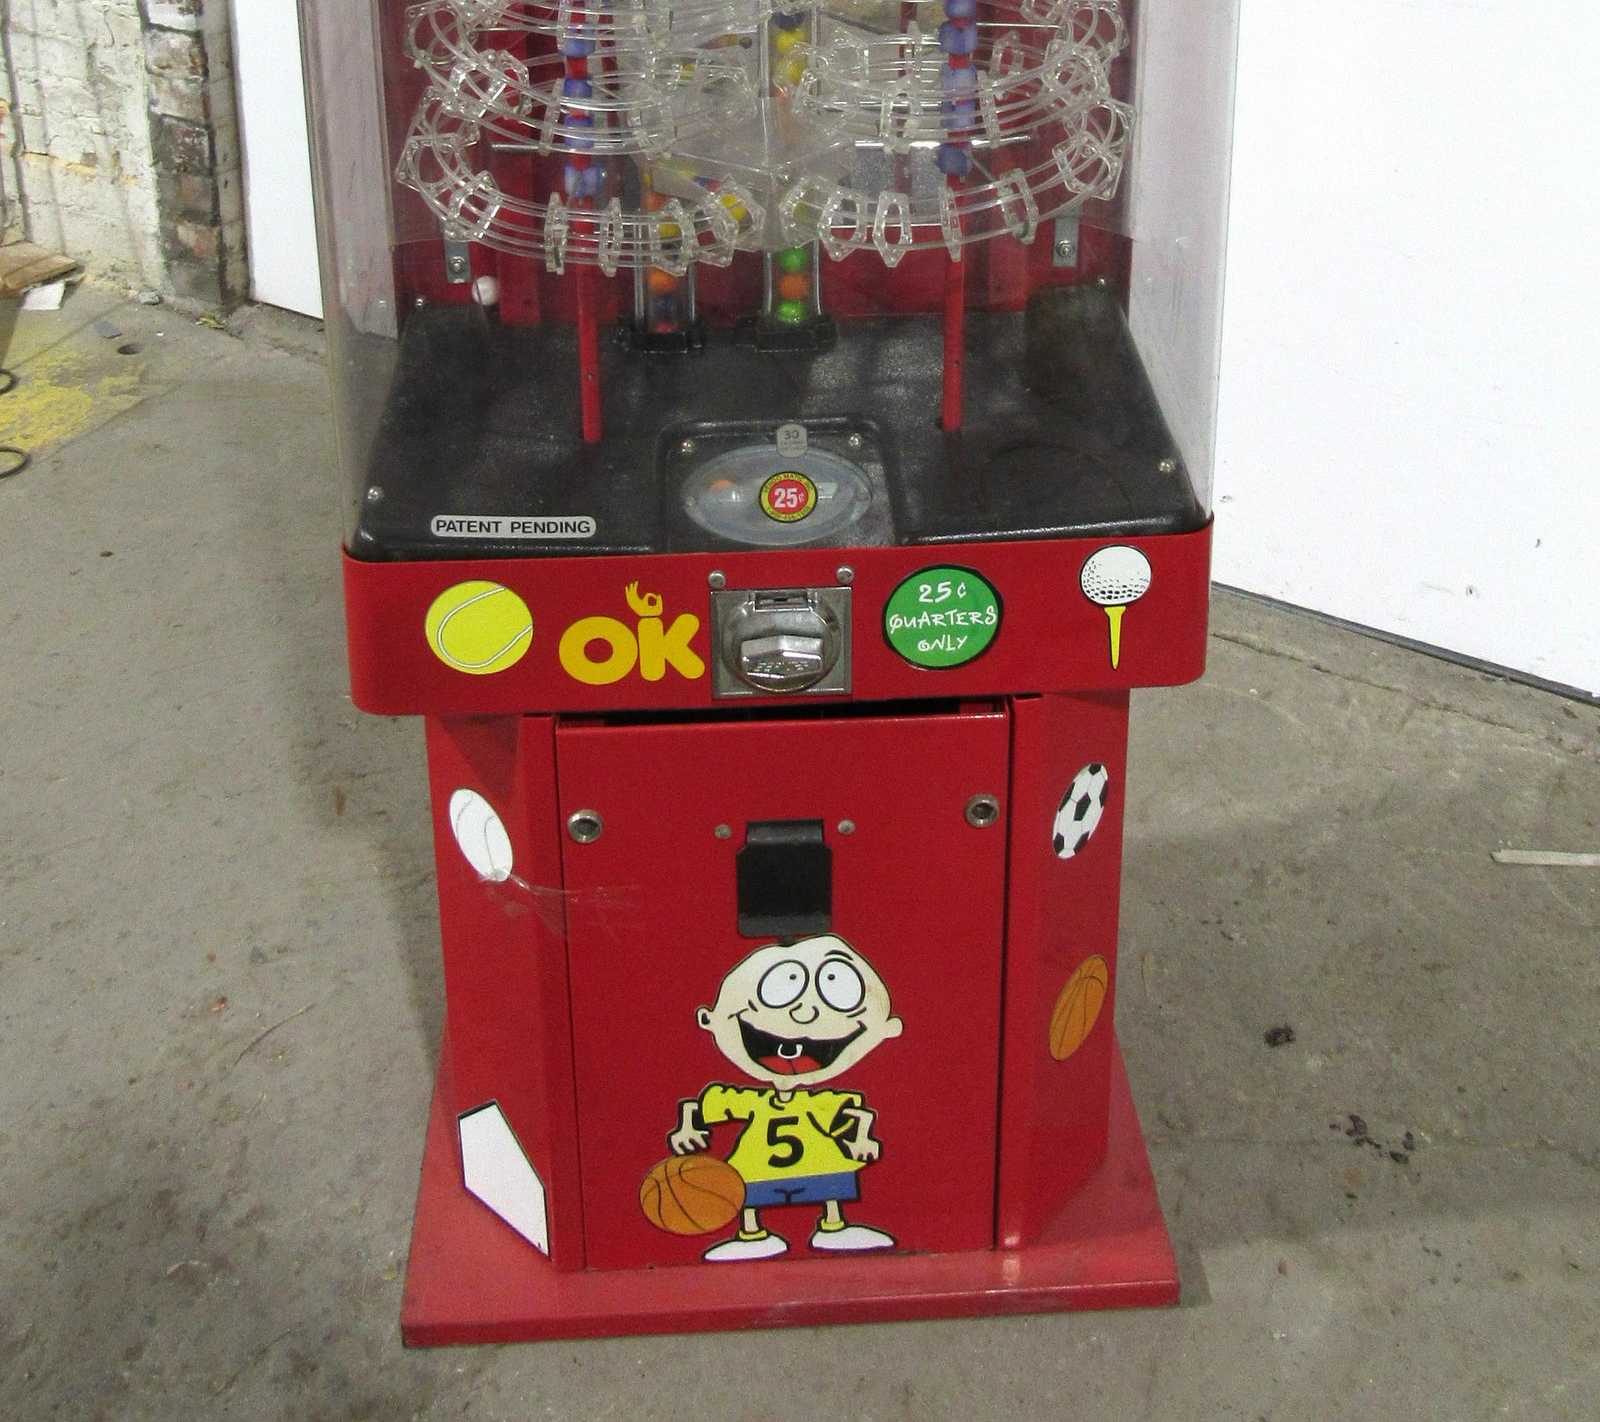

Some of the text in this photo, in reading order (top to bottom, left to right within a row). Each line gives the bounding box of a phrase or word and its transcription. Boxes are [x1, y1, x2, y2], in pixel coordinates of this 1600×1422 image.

[436, 519, 591, 534] PATENT PENDING
[889, 605, 997, 634] QUARTERS
[559, 613, 705, 685] OK
[917, 634, 968, 652] ONLY
[767, 1116, 804, 1167] 5
